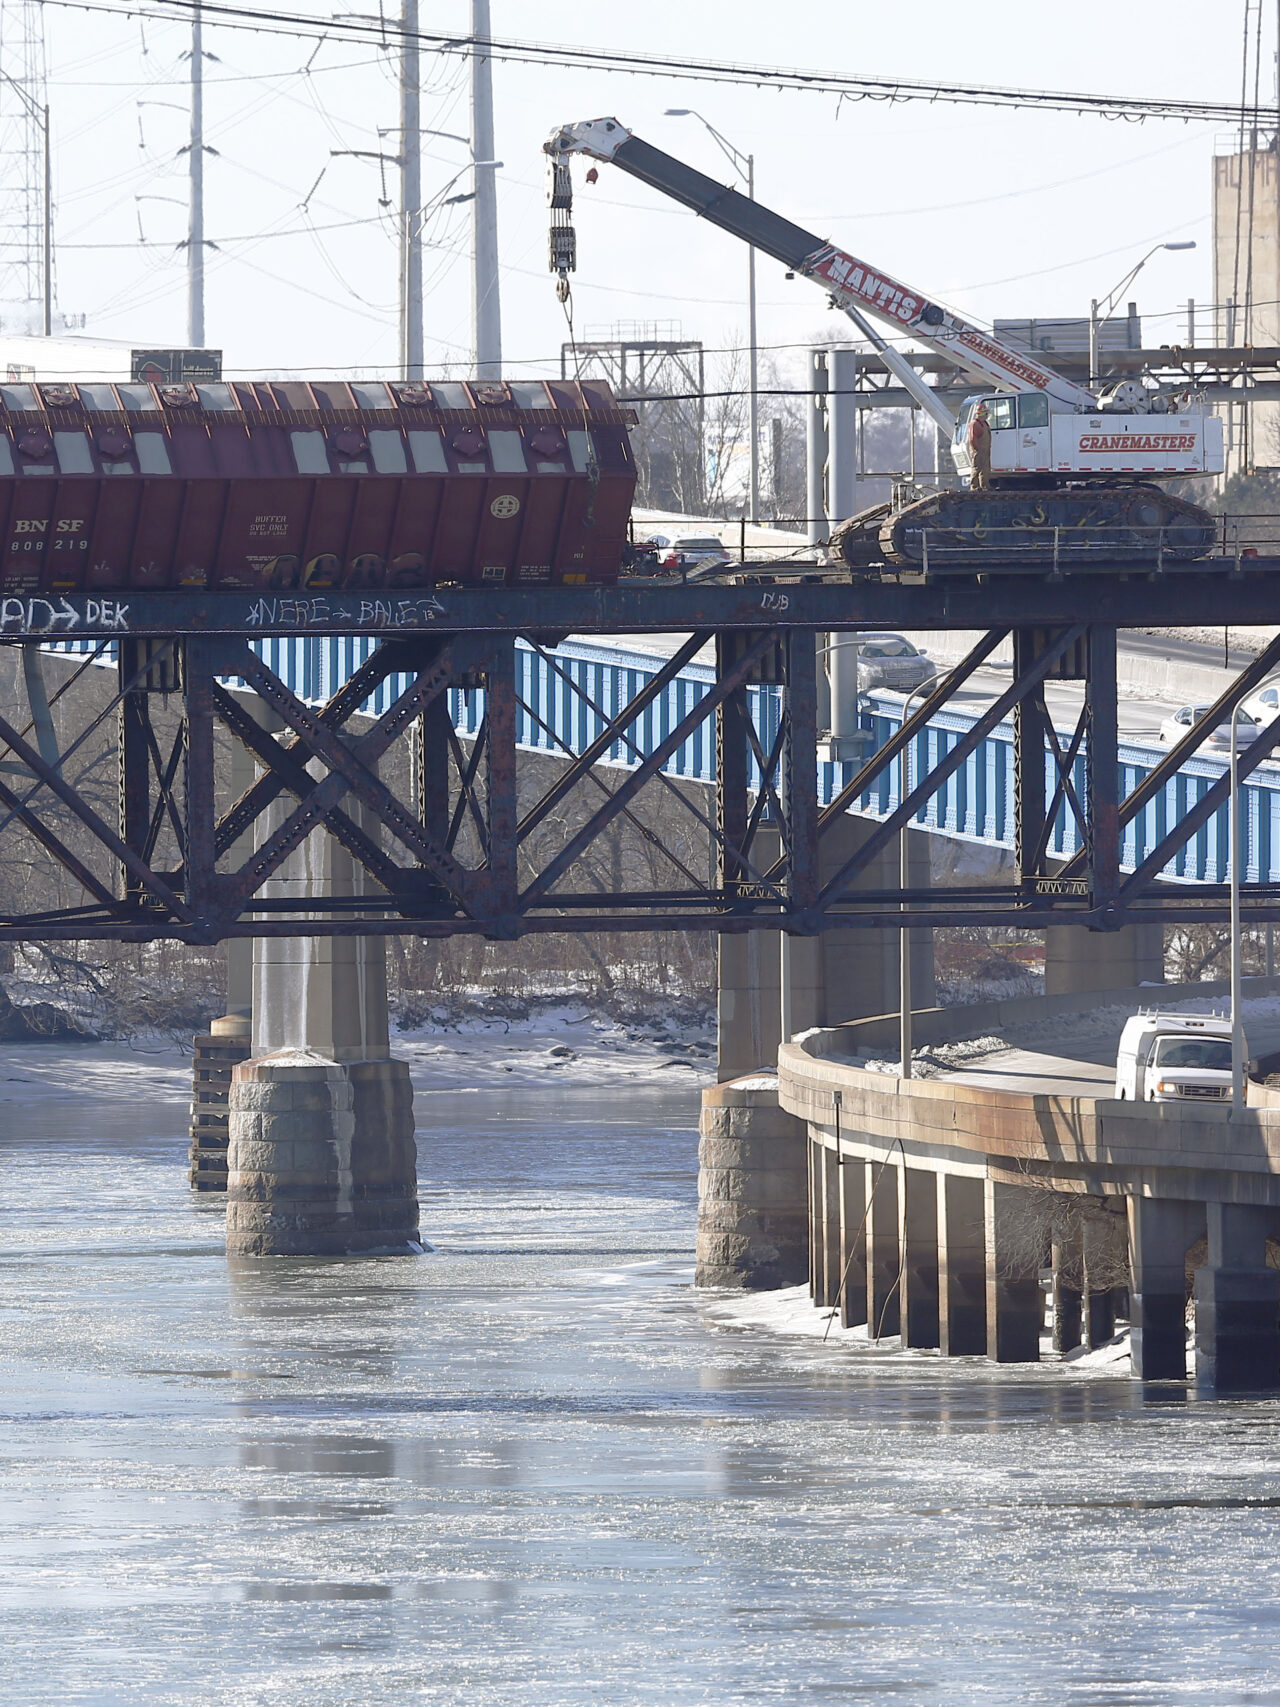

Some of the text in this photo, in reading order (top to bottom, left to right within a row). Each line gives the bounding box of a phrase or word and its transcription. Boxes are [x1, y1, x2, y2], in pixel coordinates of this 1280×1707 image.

[827, 255, 918, 321] MANTIS
[959, 331, 1052, 389] CRANEMASTERS
[1078, 435, 1196, 450] CRANEMASTERS
[86, 598, 130, 630] DEK
